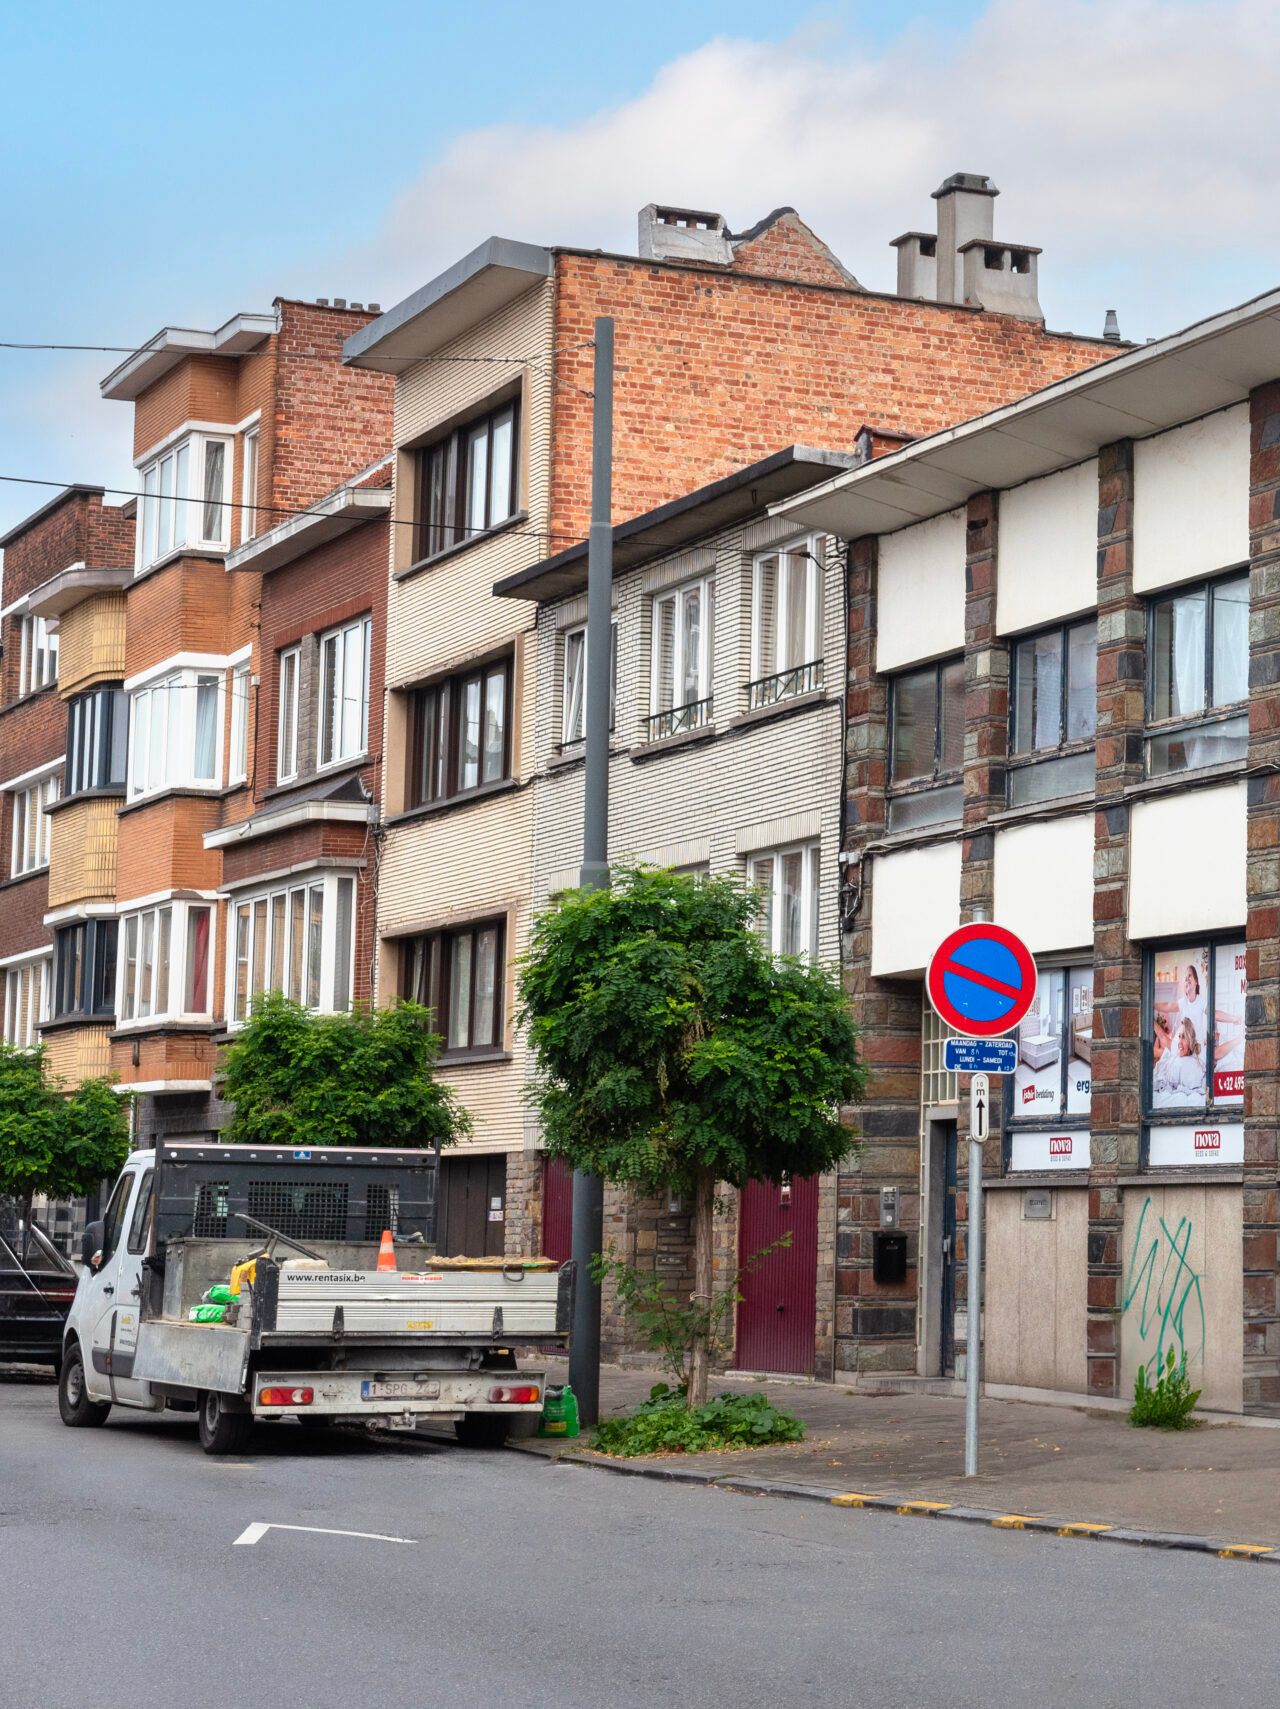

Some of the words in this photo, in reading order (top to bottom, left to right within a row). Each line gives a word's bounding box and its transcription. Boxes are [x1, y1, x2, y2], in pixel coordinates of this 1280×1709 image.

[985, 1041, 1013, 1049] ZATERDAG
[982, 1057, 1003, 1065] SAMEDI
[976, 1088, 985, 1096] m
[1036, 1088, 1054, 1102] bedding
[1050, 1138, 1072, 1153] nova
[1195, 1133, 1219, 1148] nova
[287, 1273, 366, 1283] www.rentasix.be
